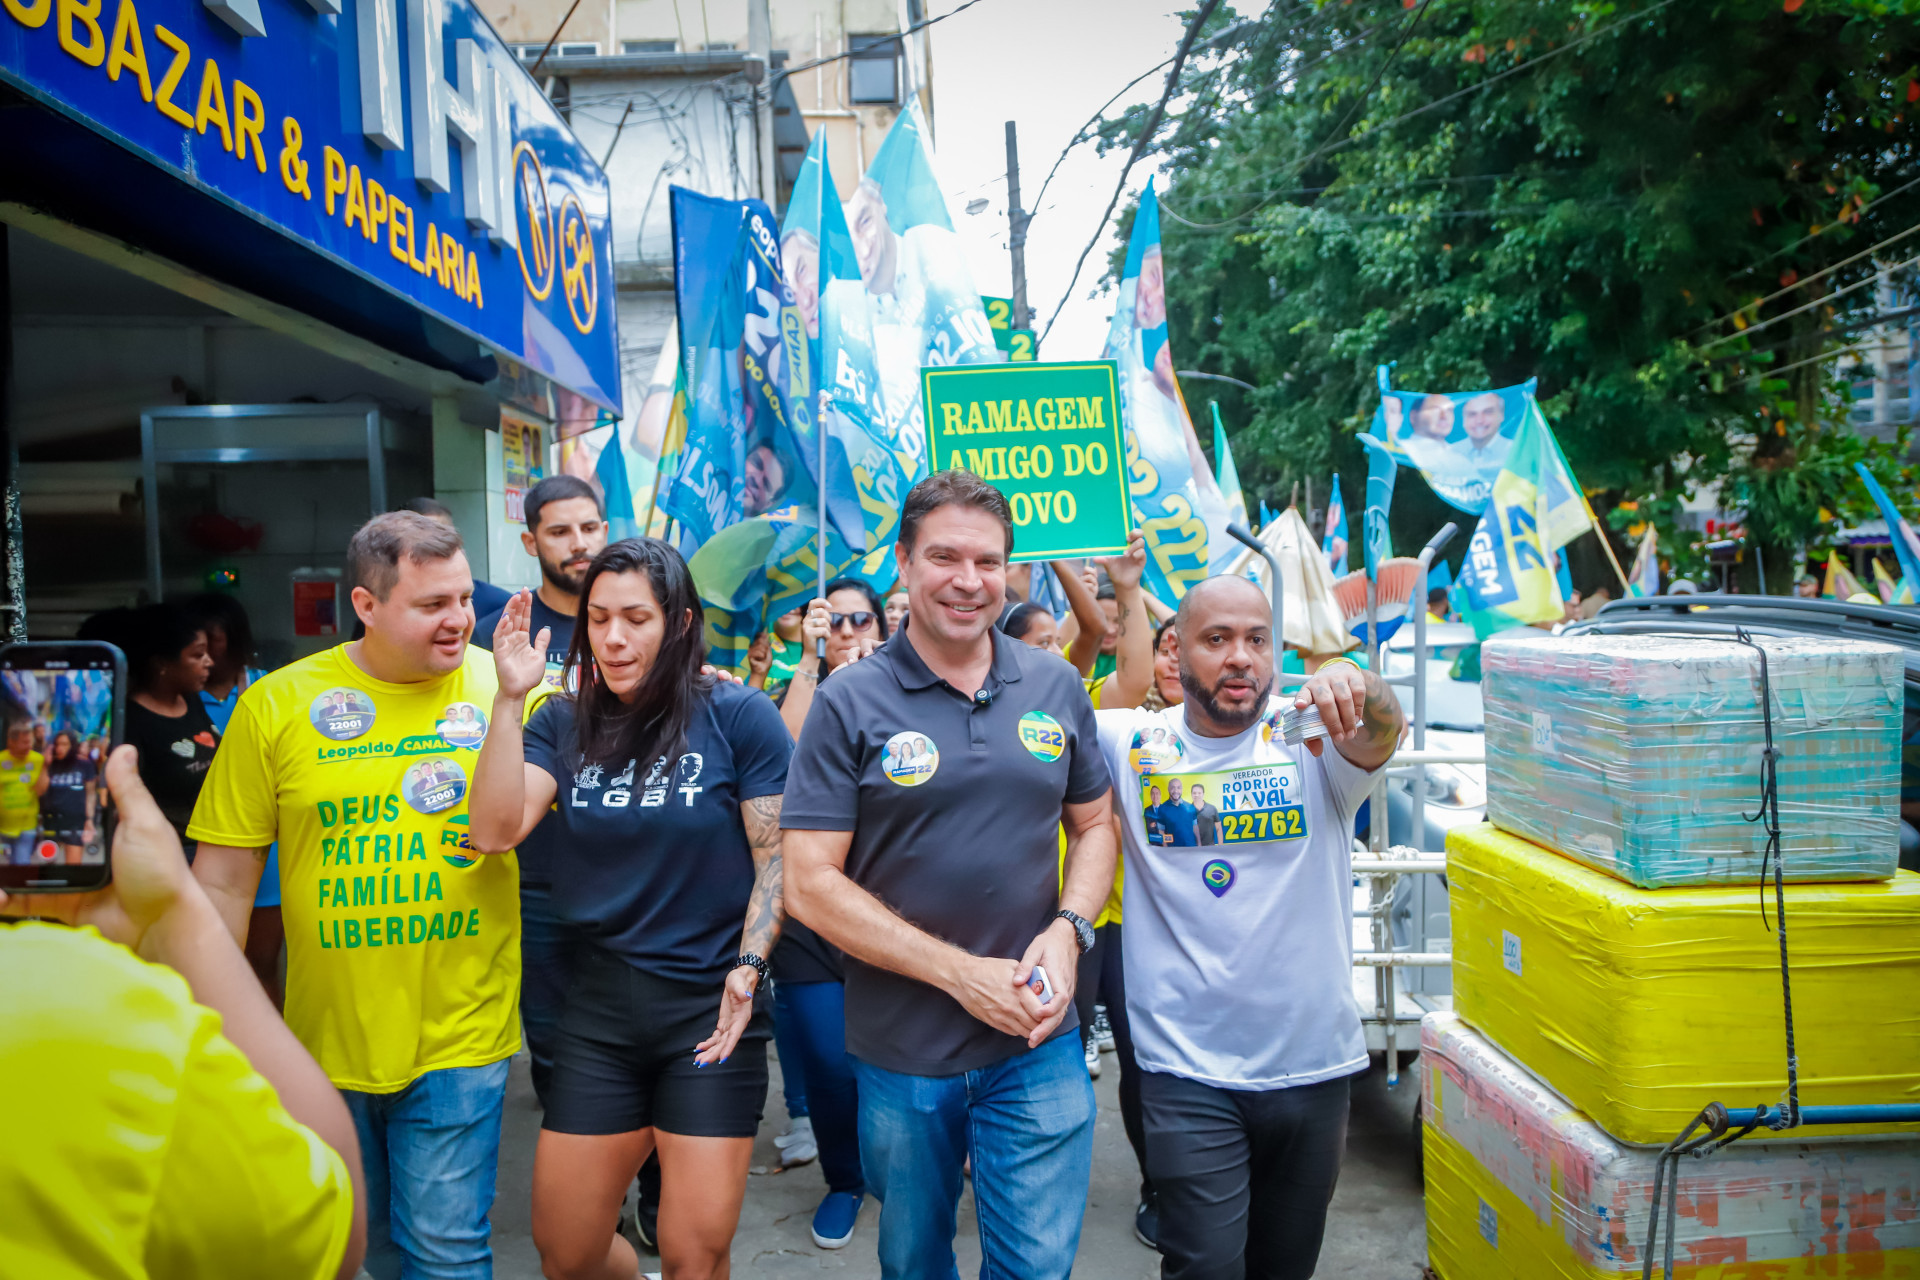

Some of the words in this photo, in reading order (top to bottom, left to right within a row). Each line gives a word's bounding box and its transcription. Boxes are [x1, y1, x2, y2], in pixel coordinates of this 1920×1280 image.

[280, 117, 311, 200] &
[324, 146, 484, 309] PAPELARIA
[941, 396, 1106, 436] RAMAGEM
[949, 442, 1055, 482] AMIGO
[1062, 441, 1109, 477] DO
[1009, 489, 1078, 527] OVO
[329, 719, 362, 731] 22001
[1022, 727, 1063, 746] R22
[318, 741, 394, 760] Leopoldo
[917, 764, 932, 774] 22
[1233, 769, 1273, 780] VEREADOR
[423, 788, 456, 806] 22001
[571, 786, 703, 808] LGBT
[1222, 776, 1289, 793] RODRIGO
[317, 794, 400, 828] DEUS
[1222, 789, 1292, 811] NAVAL
[1223, 809, 1302, 840] 22762
[321, 826, 427, 867] PÁTRIA
[318, 867, 444, 908] FAMÍLIA
[318, 908, 480, 949] LIBERDADE
